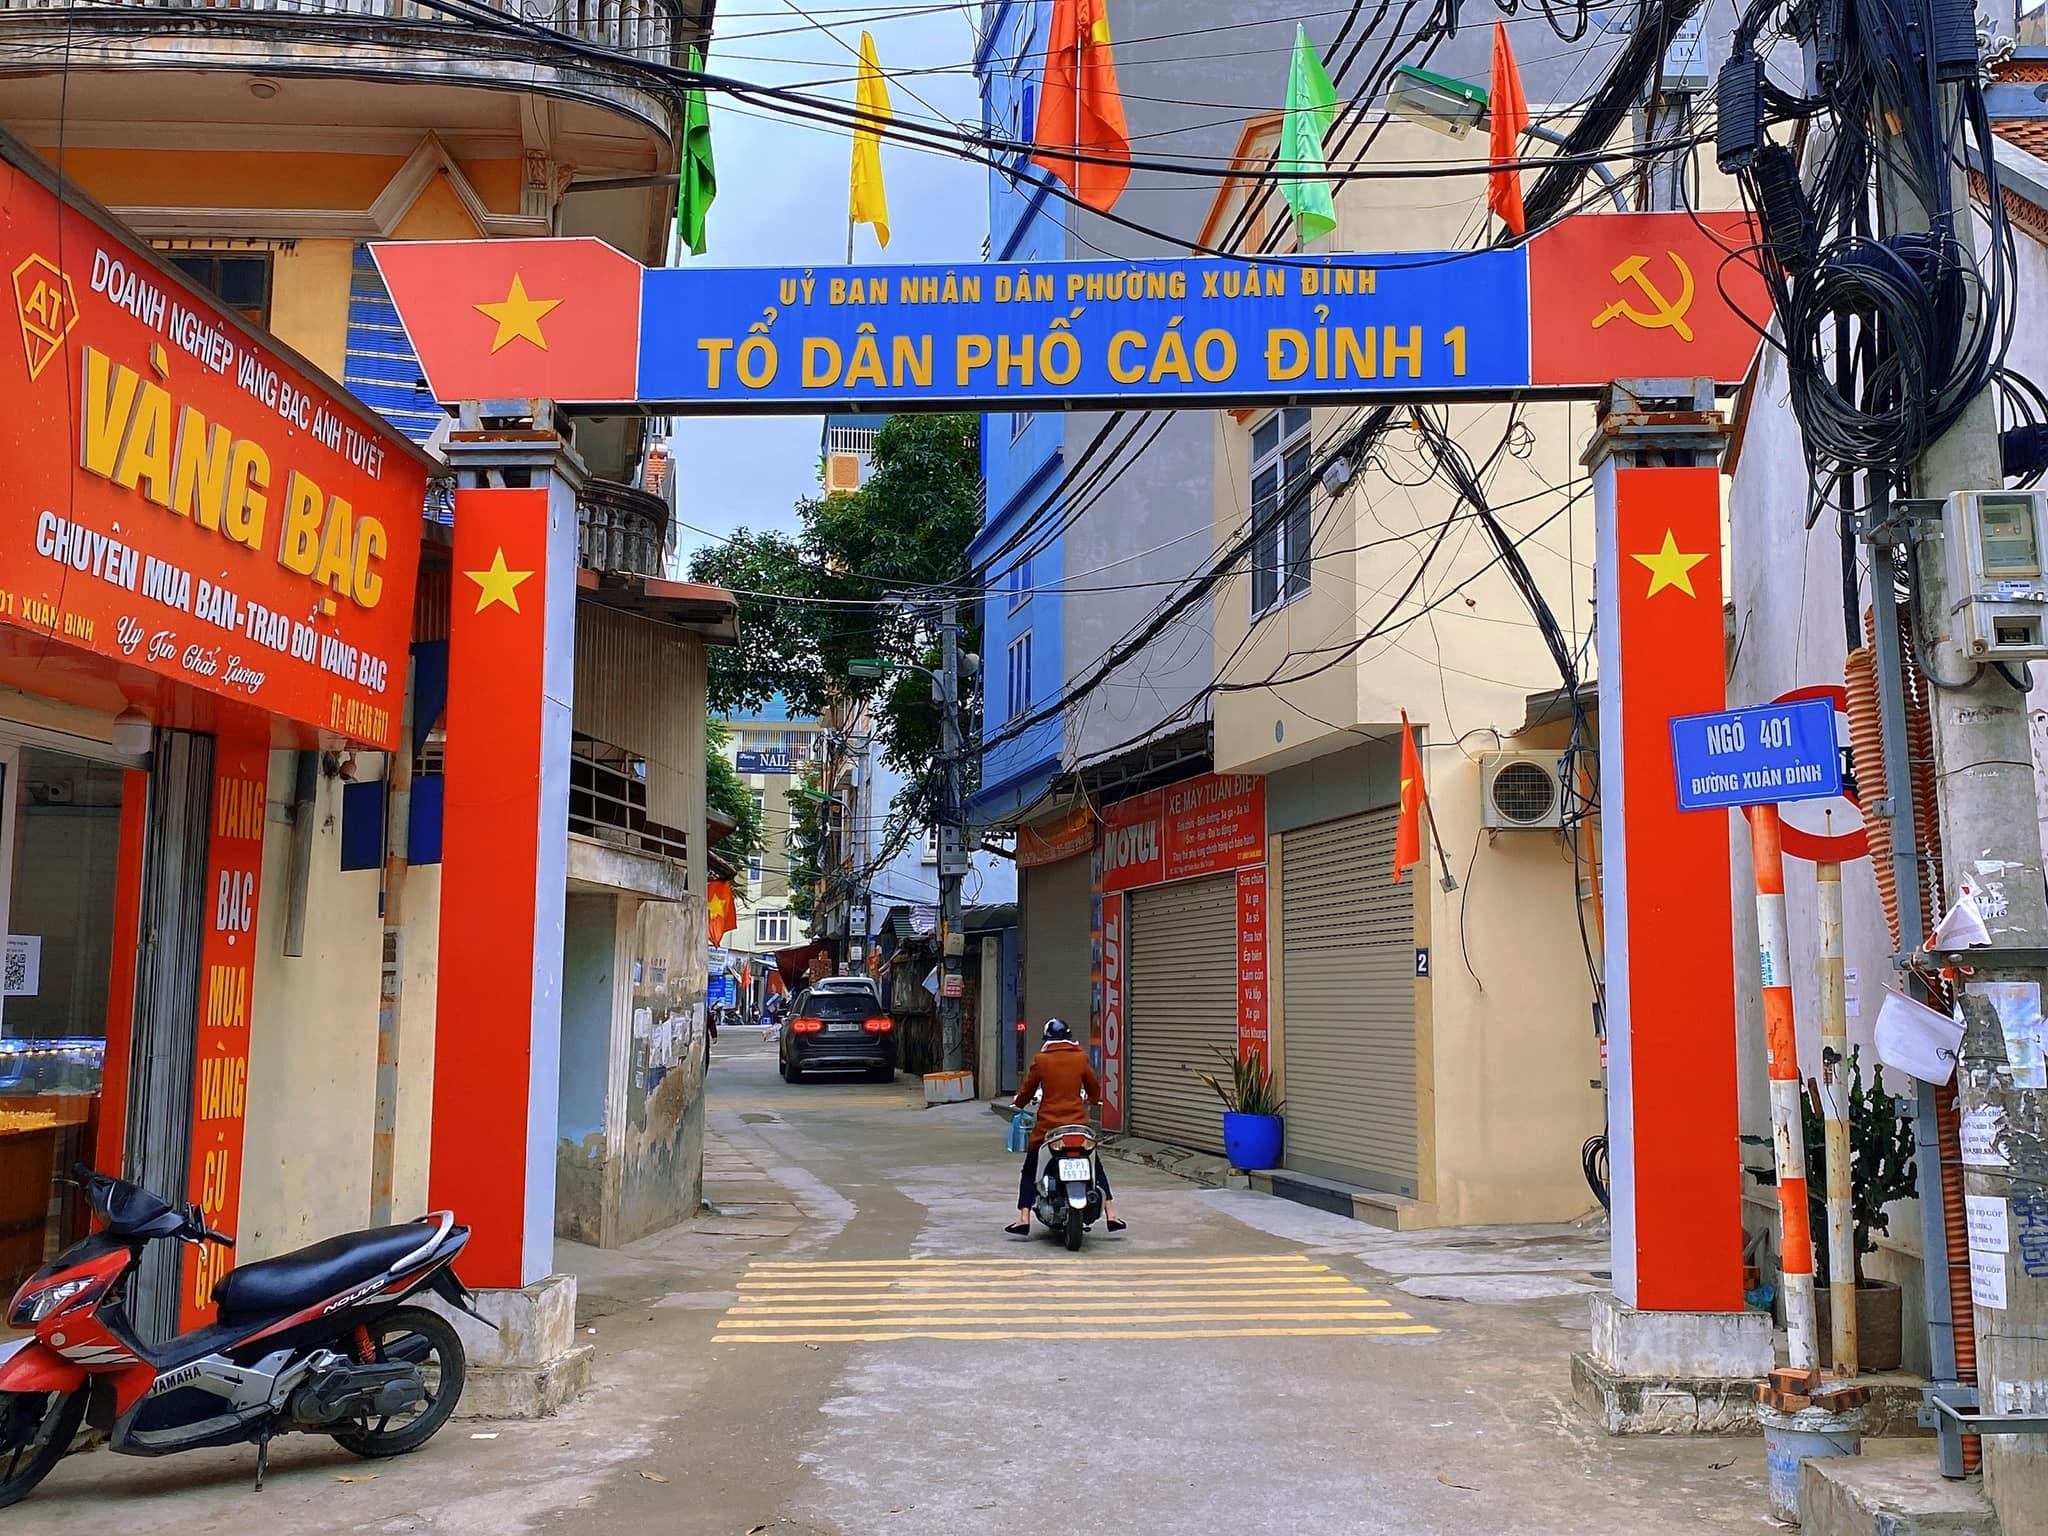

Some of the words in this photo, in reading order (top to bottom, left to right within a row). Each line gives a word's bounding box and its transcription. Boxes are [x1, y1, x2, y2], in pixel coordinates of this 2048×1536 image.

[24, 279, 66, 330] AT
[830, 277, 889, 306] BAN
[900, 270, 981, 304] NHÂN
[995, 268, 1055, 303] DÂN
[1067, 265, 1187, 301] PHƯỜNG
[1202, 263, 1286, 298] XUÂN
[1301, 257, 1377, 296] ĐỈNH
[90, 248, 166, 332] DOANH
[169, 303, 234, 376] NGHIỆP
[237, 346, 279, 409] VÀNG
[279, 381, 311, 436] BẠC
[345, 433, 385, 481] TUYẾT
[697, 306, 779, 390] TỔ
[801, 322, 934, 389] DÂN
[956, 307, 1087, 387] PHỐ
[1107, 315, 1238, 384] CÁO
[1264, 304, 1423, 381] ĐỈNH
[1442, 326, 1468, 377] 1
[80, 342, 272, 550] VÀNG
[278, 469, 389, 616] BẠC
[36, 510, 136, 592] CHUYÊN
[142, 557, 192, 614] MUA
[290, 604, 319, 665] ĐỔI
[320, 628, 358, 681] VÀNG
[358, 651, 388, 696] BẠC
[116, 615, 144, 656] Uy
[147, 630, 177, 662] Tín
[182, 644, 218, 677] Chất
[760, 754, 789, 766] NAIL
[1706, 717, 1745, 755] NGÕ
[1760, 716, 1792, 749] 401
[218, 761, 264, 841] VÀNG
[1692, 771, 1739, 795] ĐƯỜNG
[1743, 766, 1782, 790] XUÂN
[1785, 759, 1822, 785] ĐỈNH
[1104, 820, 1158, 871] MOTUL
[216, 870, 254, 946] BẠC
[1418, 954, 1427, 971] 2
[207, 965, 246, 1027] MUA
[1105, 914, 1119, 1111] MOTUL
[200, 1040, 245, 1121] VÀNG
[202, 1131, 228, 1215] CŨ
[323, 1279, 385, 1314] NOUVO
[151, 1366, 201, 1394] YAMAHA
